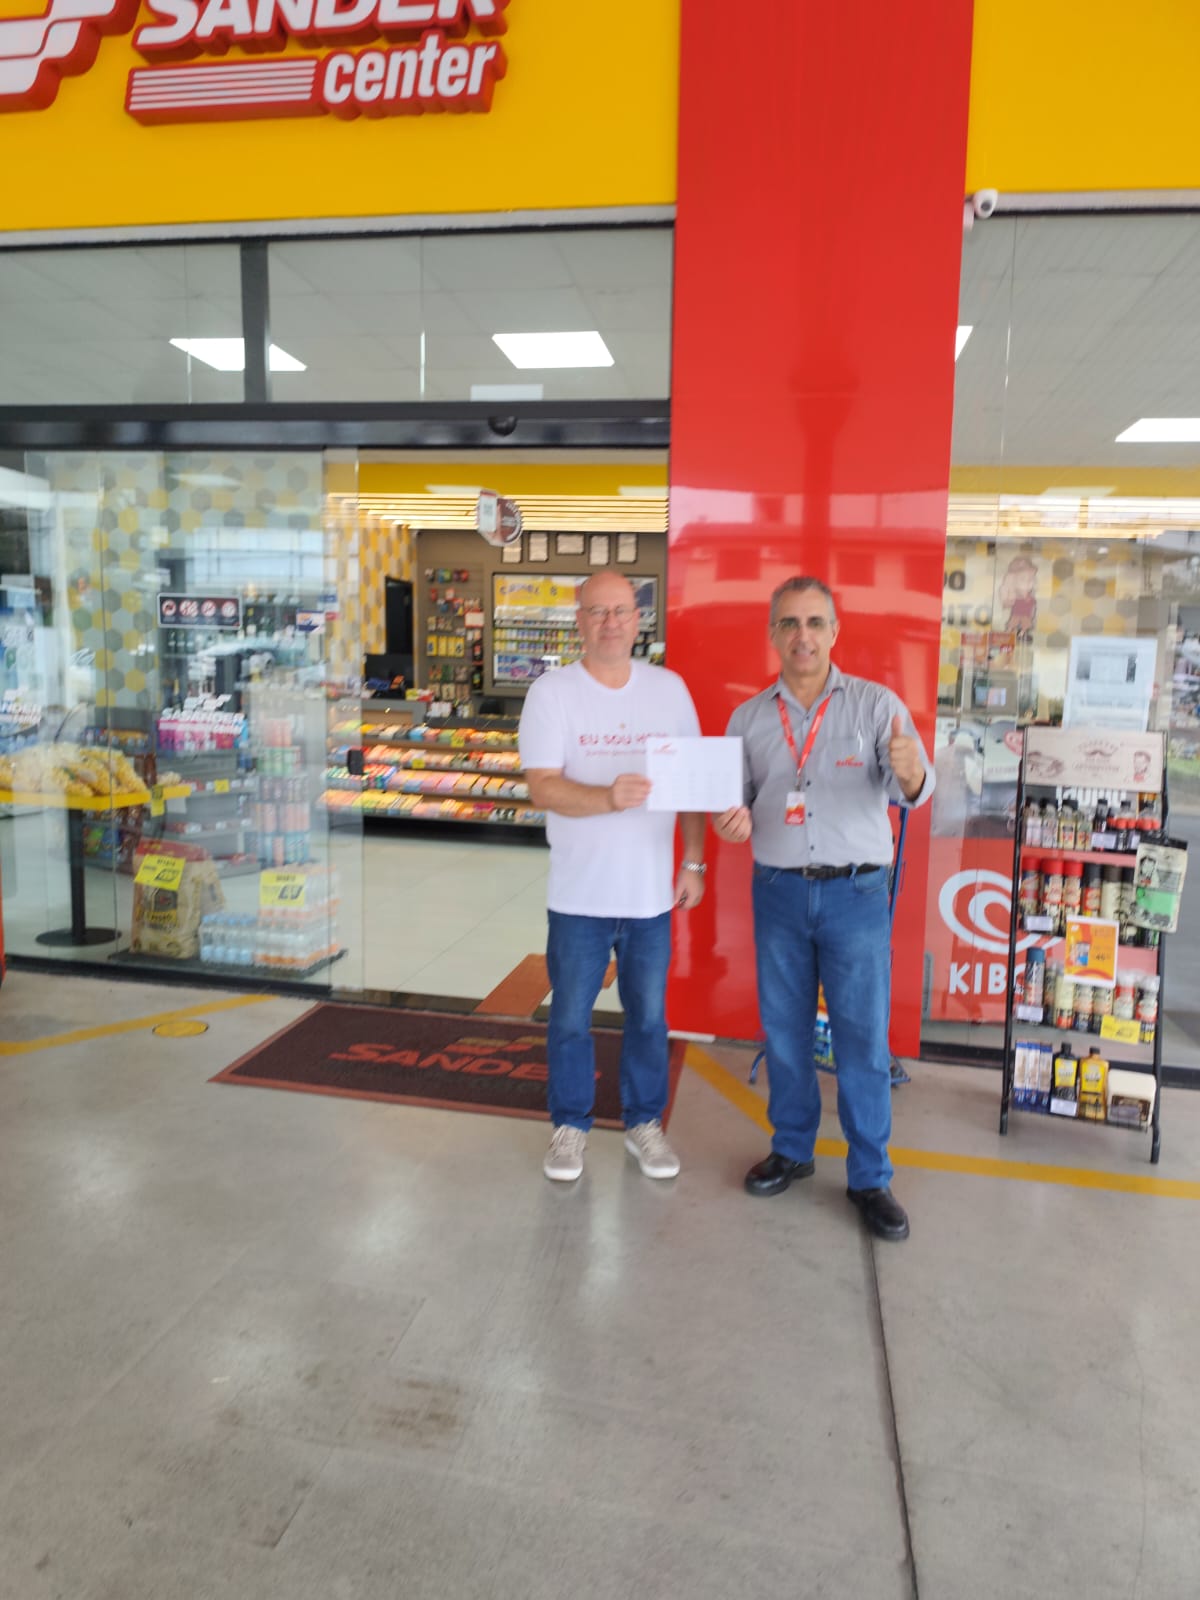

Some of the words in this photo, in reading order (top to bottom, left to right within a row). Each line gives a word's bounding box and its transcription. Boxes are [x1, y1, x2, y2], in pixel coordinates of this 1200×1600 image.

[136, 0, 495, 45] SAND
[323, 34, 496, 104] center
[328, 1042, 602, 1081] SANDE
